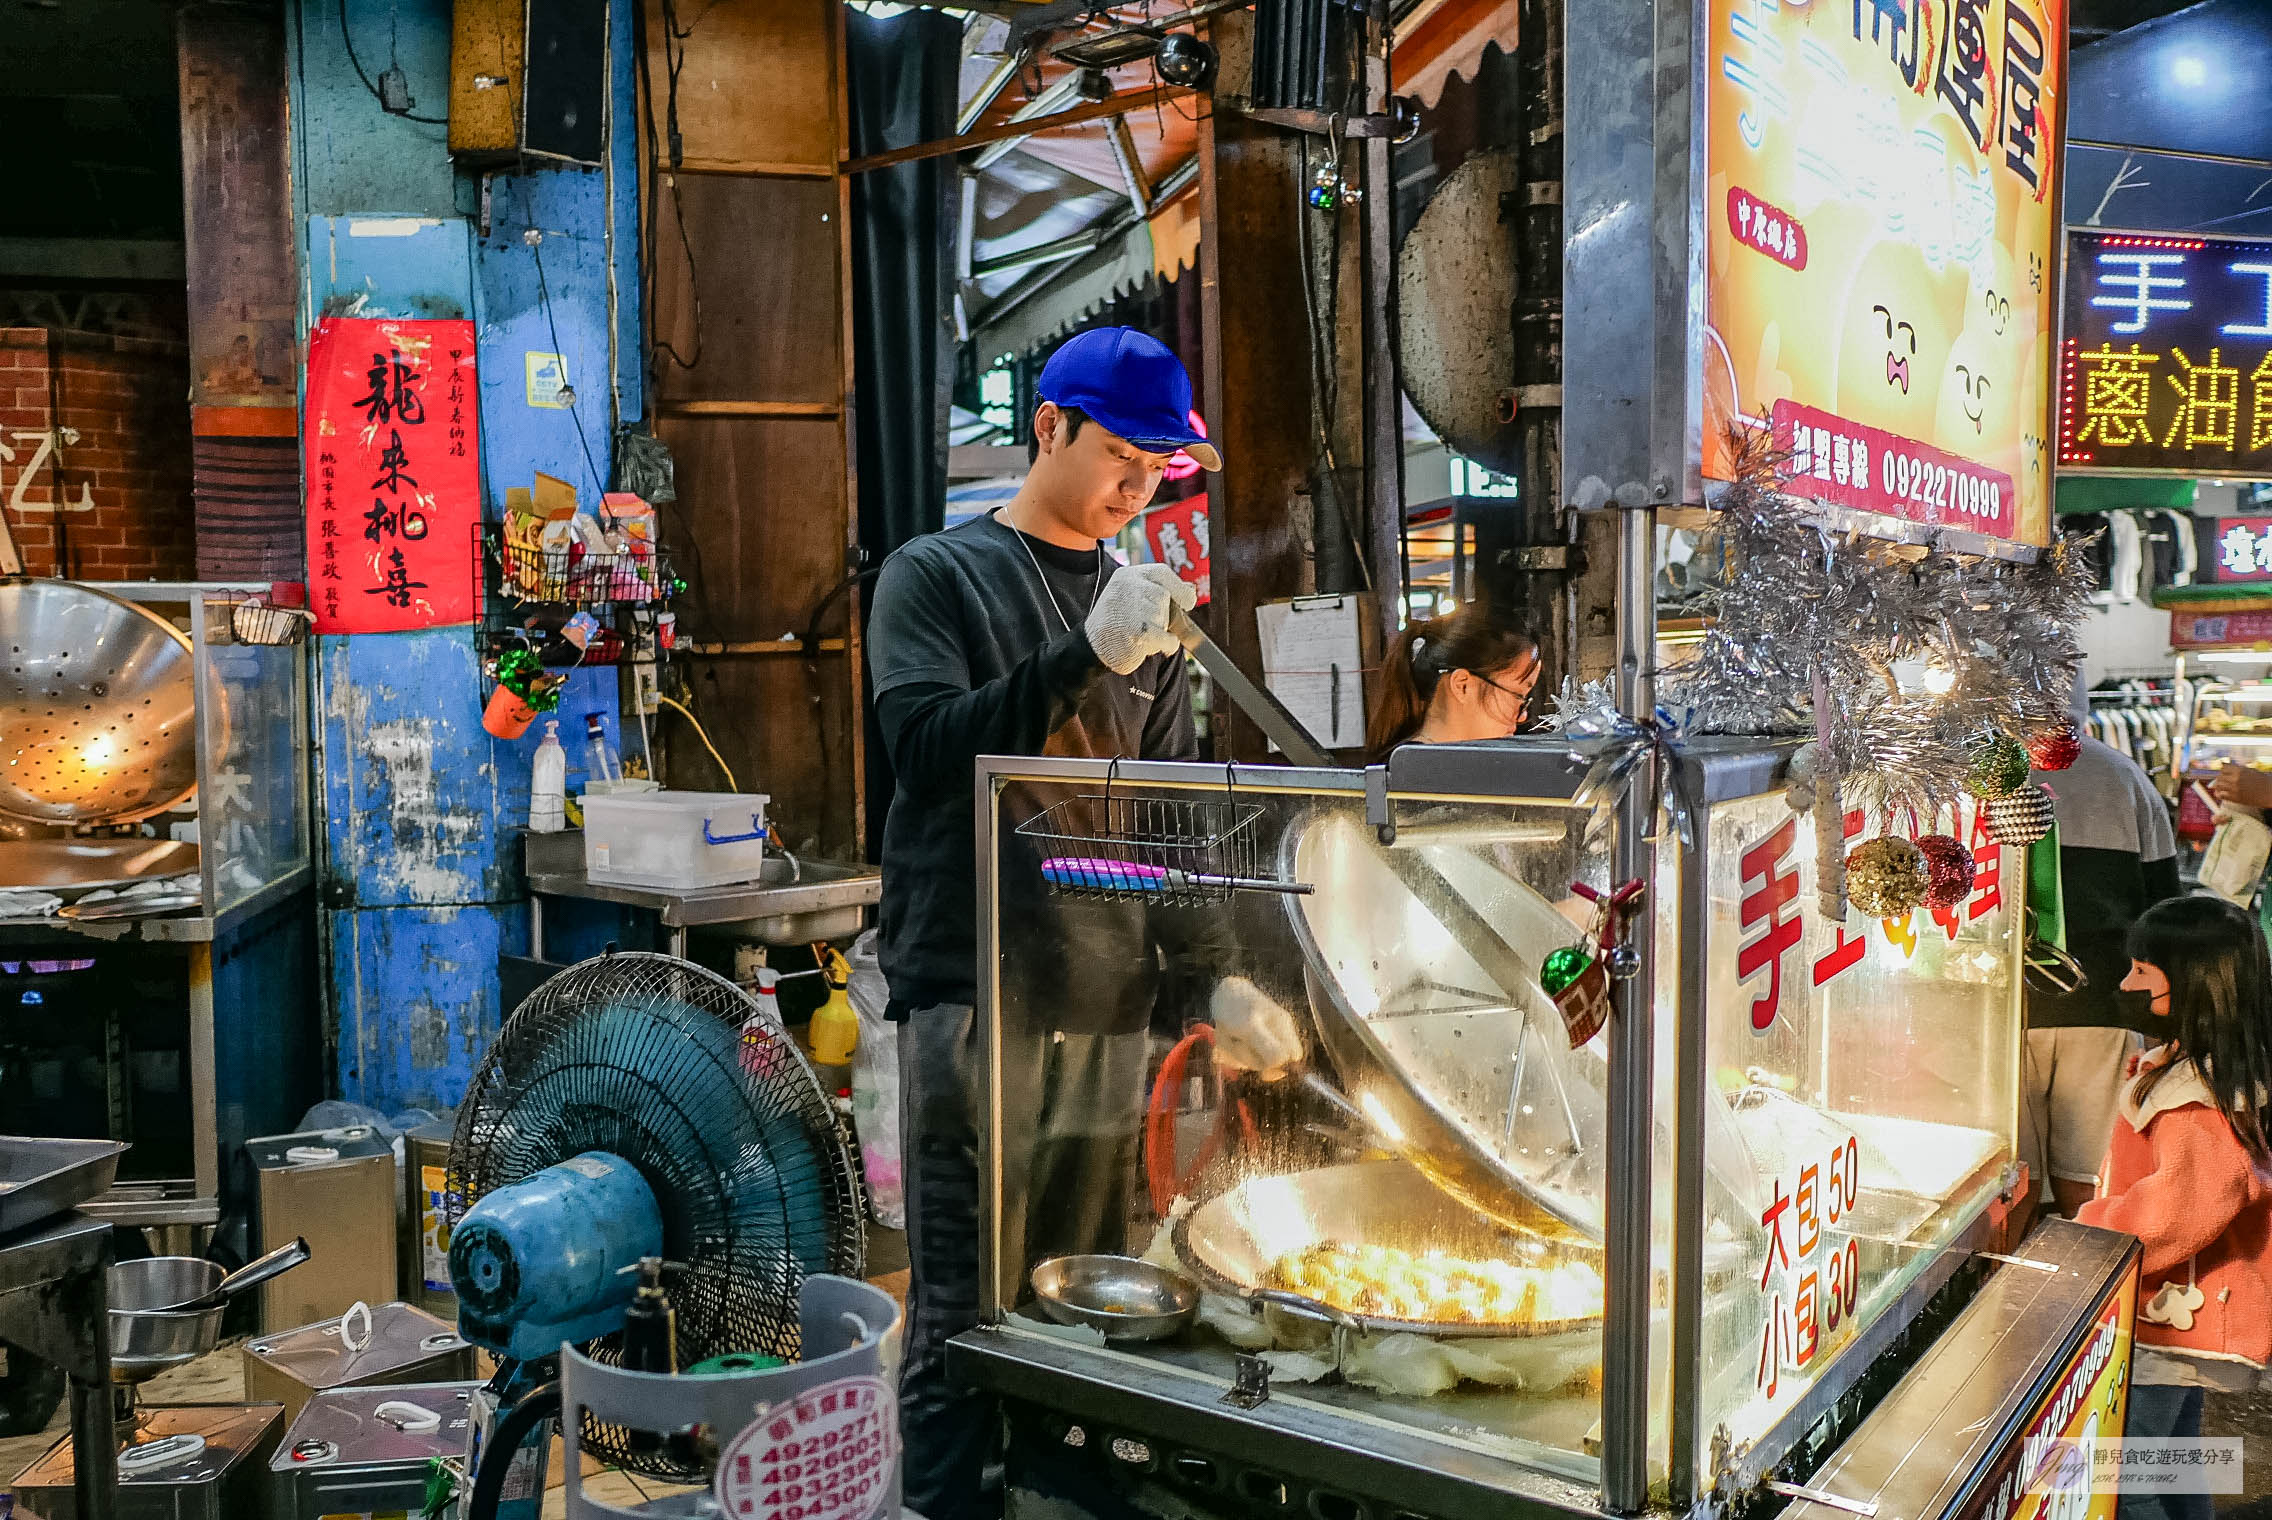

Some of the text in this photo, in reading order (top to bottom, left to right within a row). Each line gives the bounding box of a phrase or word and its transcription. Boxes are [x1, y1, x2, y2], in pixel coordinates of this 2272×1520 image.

[319, 452, 338, 512] 桃園市長
[351, 349, 429, 609] 龍來桃喜
[1792, 418, 2001, 521] 加盟專線 0922270999
[320, 519, 343, 581] 張善政
[1761, 1135, 1858, 1293] 大包 50
[1757, 1238, 1859, 1400] 小包 30
[760, 1410, 879, 1464] 4929271
